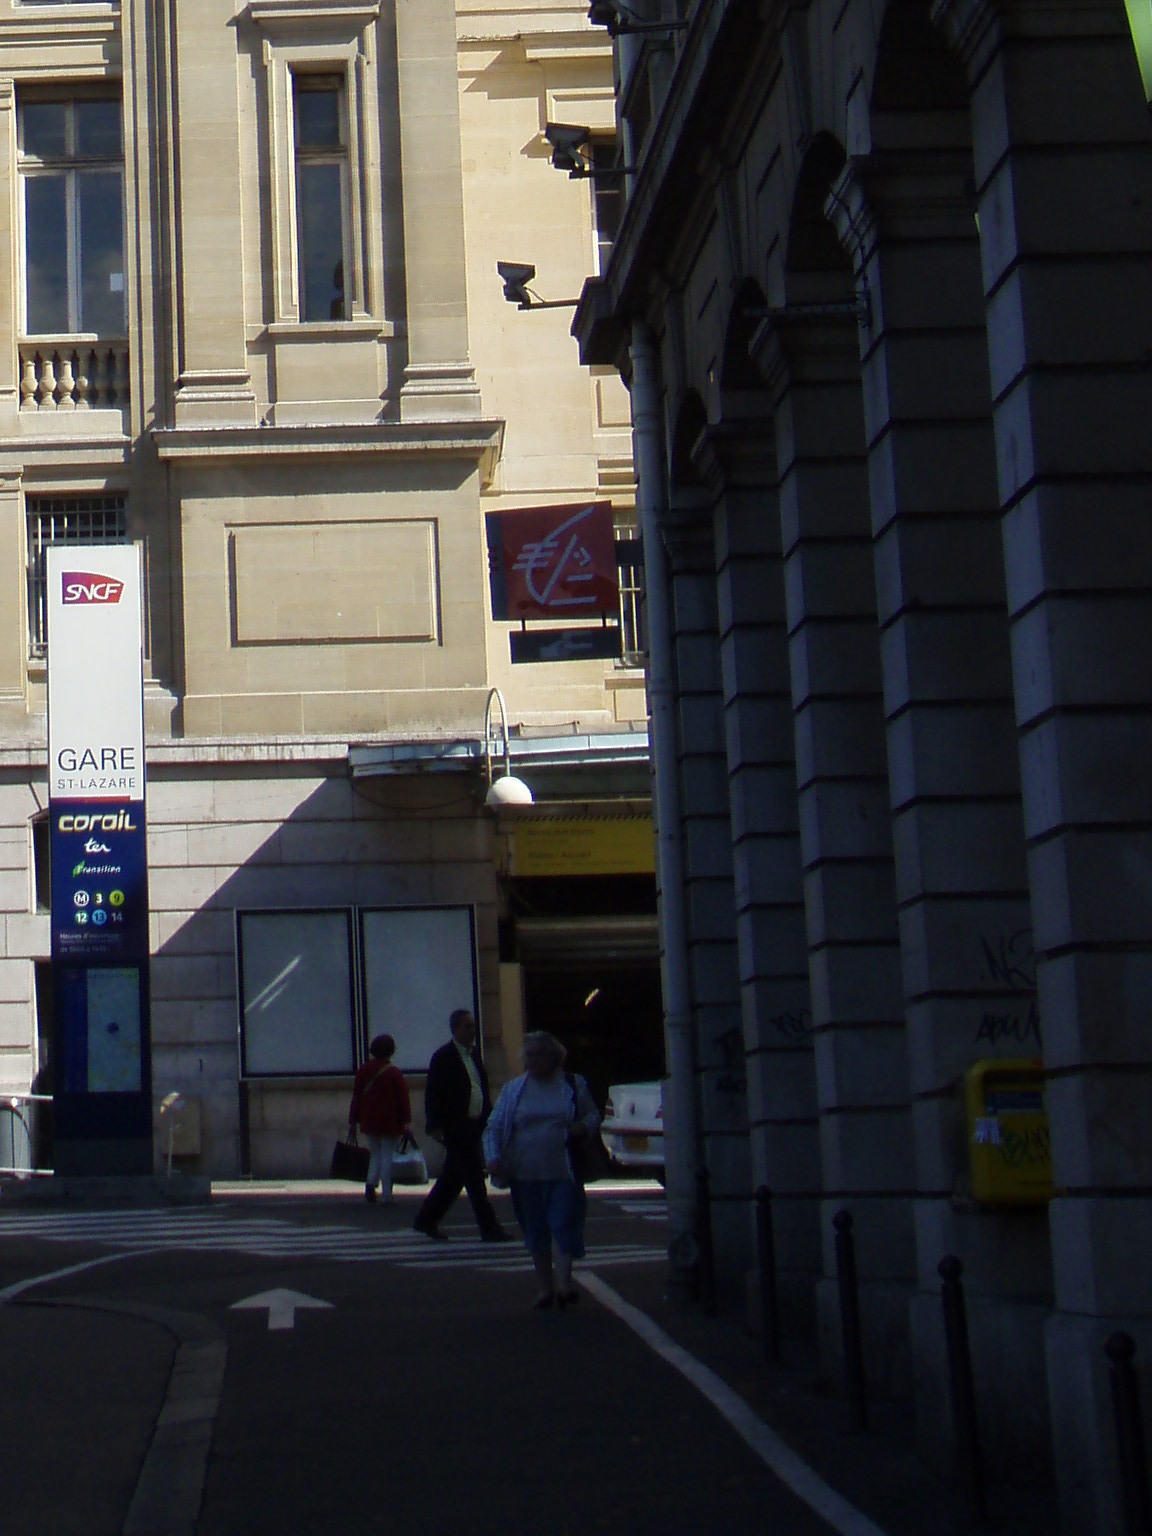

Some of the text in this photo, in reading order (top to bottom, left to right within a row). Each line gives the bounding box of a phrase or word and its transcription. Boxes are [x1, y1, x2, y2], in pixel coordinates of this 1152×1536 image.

[64, 583, 121, 602] SNCF
[58, 748, 135, 771] GARE
[58, 777, 135, 789] ST-LAZARE
[84, 837, 112, 853] ter
[75, 913, 87, 923] 12
[111, 913, 123, 922] 14
